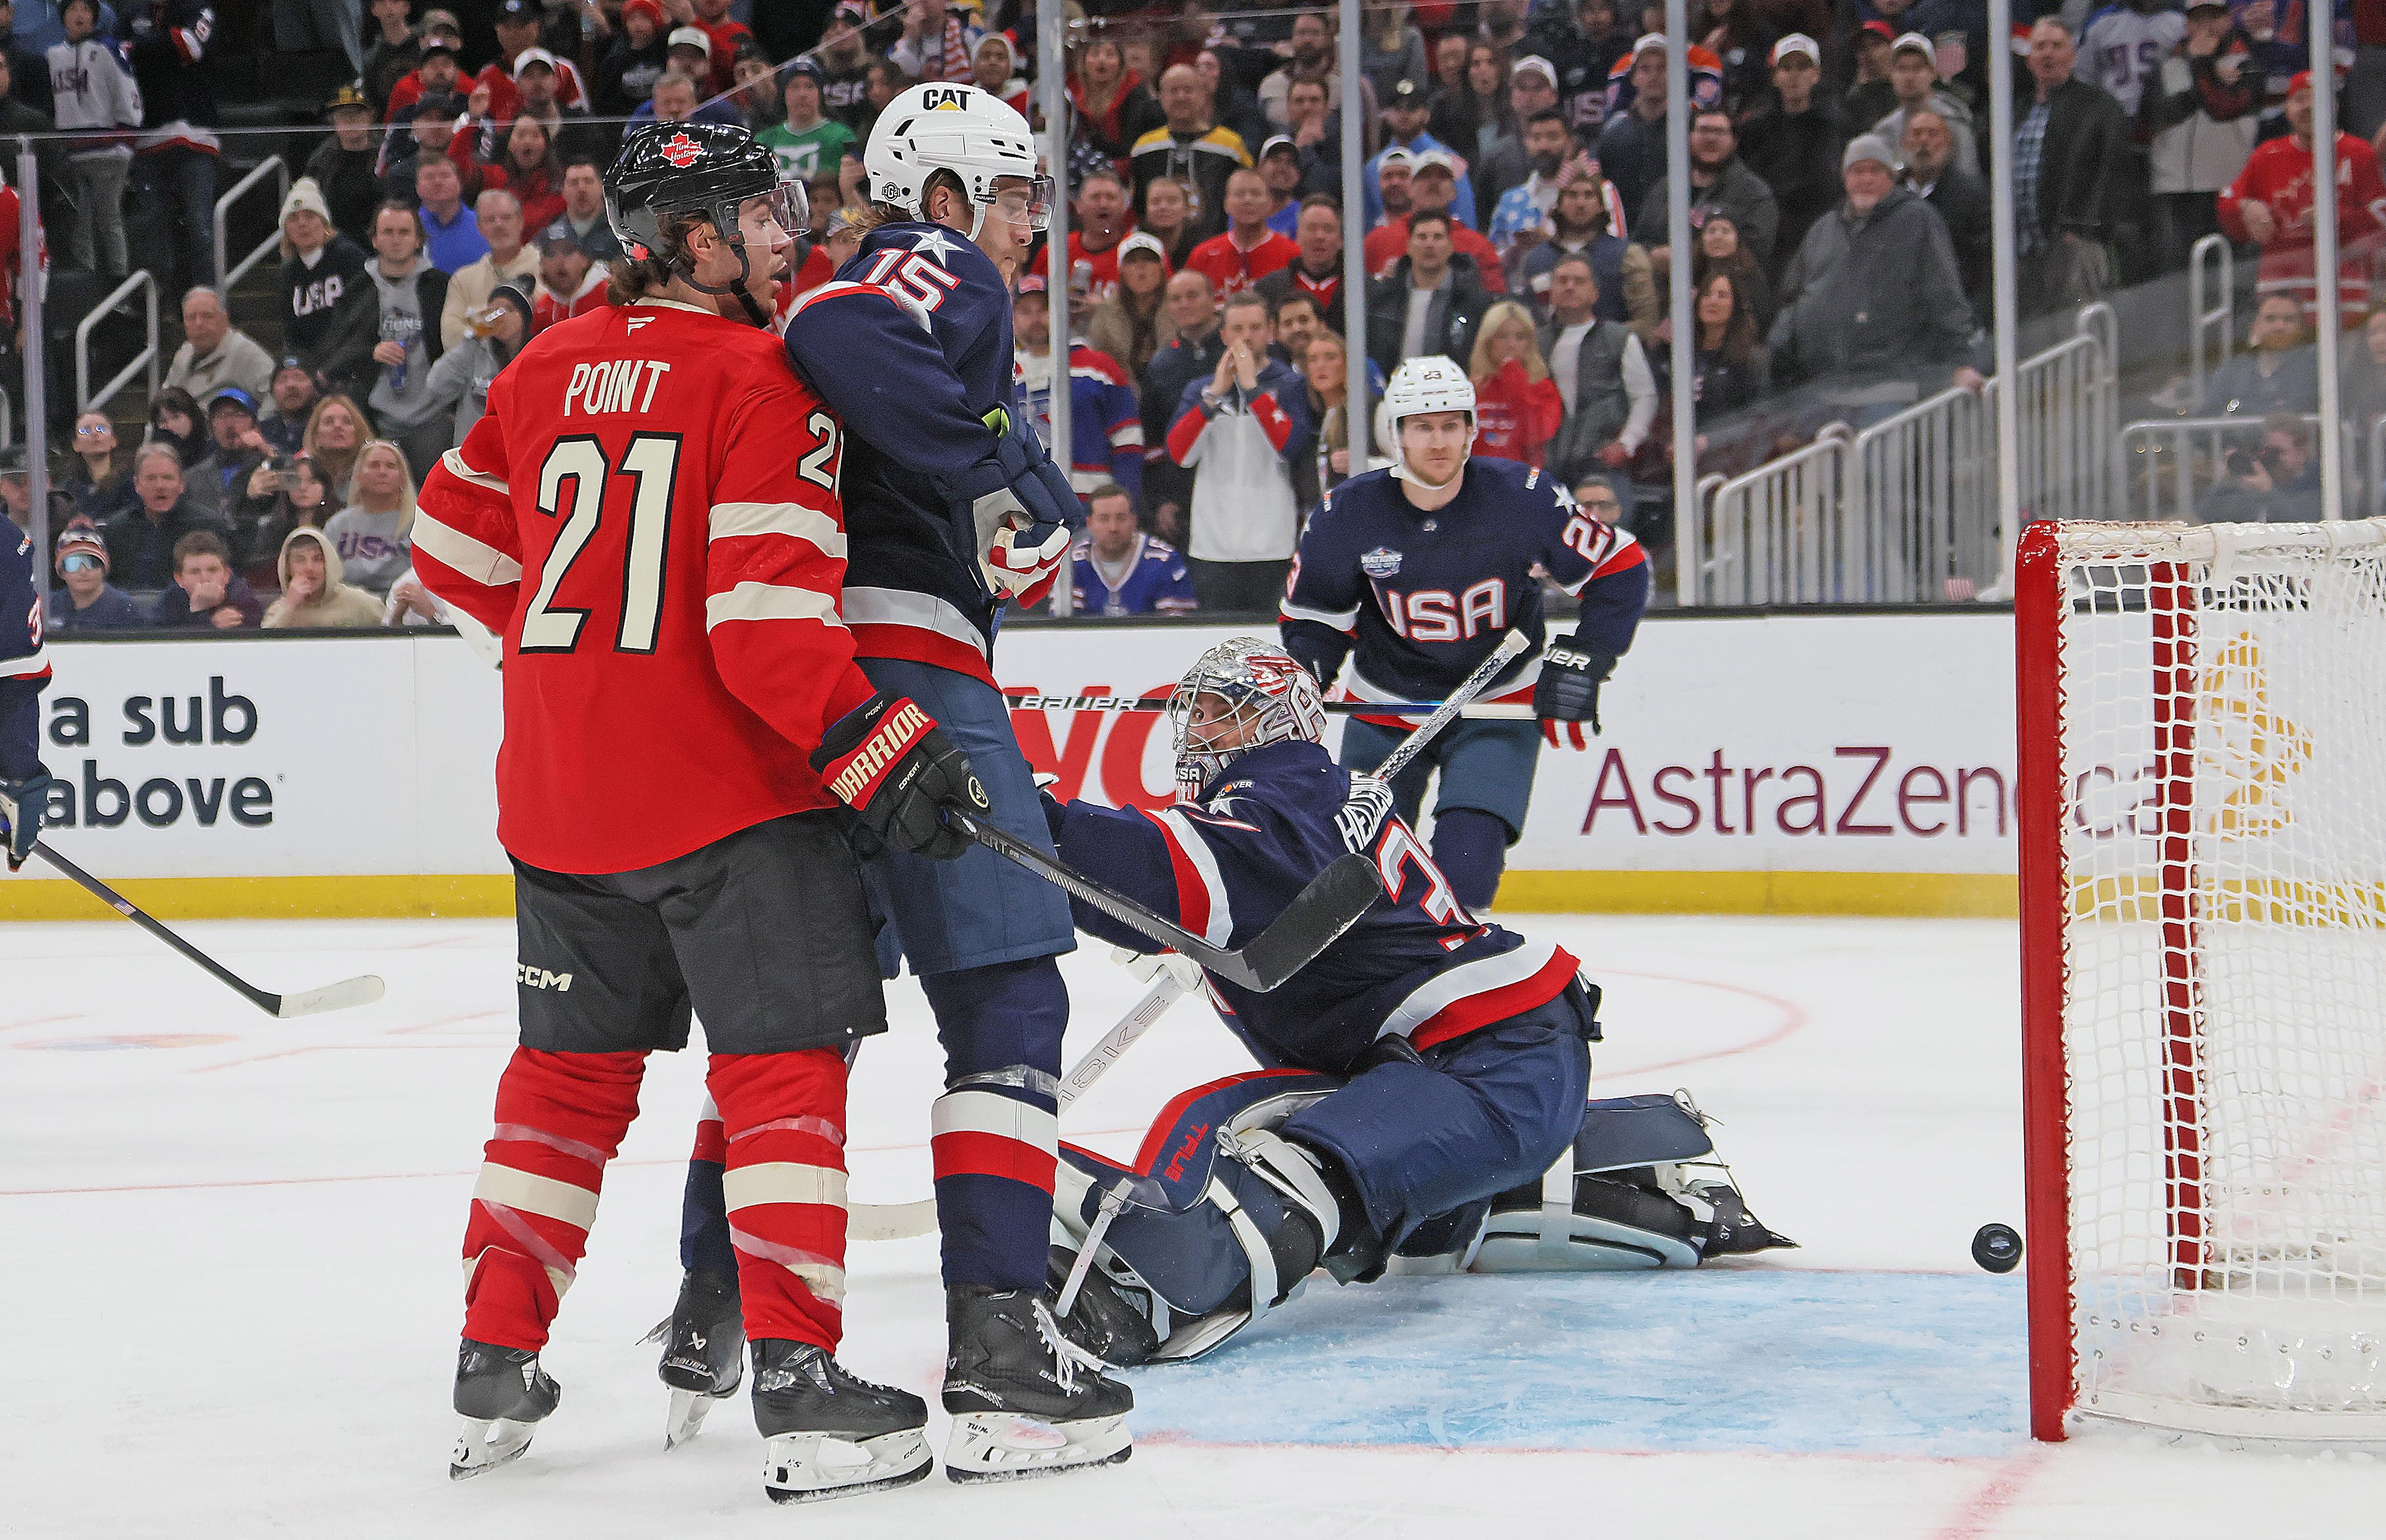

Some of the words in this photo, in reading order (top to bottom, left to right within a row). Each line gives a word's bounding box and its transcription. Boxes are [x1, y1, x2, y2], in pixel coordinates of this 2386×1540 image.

[923, 89, 971, 111] CAT
[670, 147, 699, 161] Hortons
[674, 141, 689, 150] Tim
[864, 247, 961, 313] 15
[564, 359, 670, 417] POINT
[797, 411, 844, 502] 2
[518, 430, 684, 656] 21
[1562, 505, 1610, 565] 2
[48, 697, 89, 745] a
[122, 676, 258, 745] sub
[864, 700, 884, 720] POINT
[830, 703, 930, 805] WARRIOR
[898, 761, 920, 791] COVERT
[45, 760, 273, 827] above
[1164, 1123, 1208, 1183] TRUE
